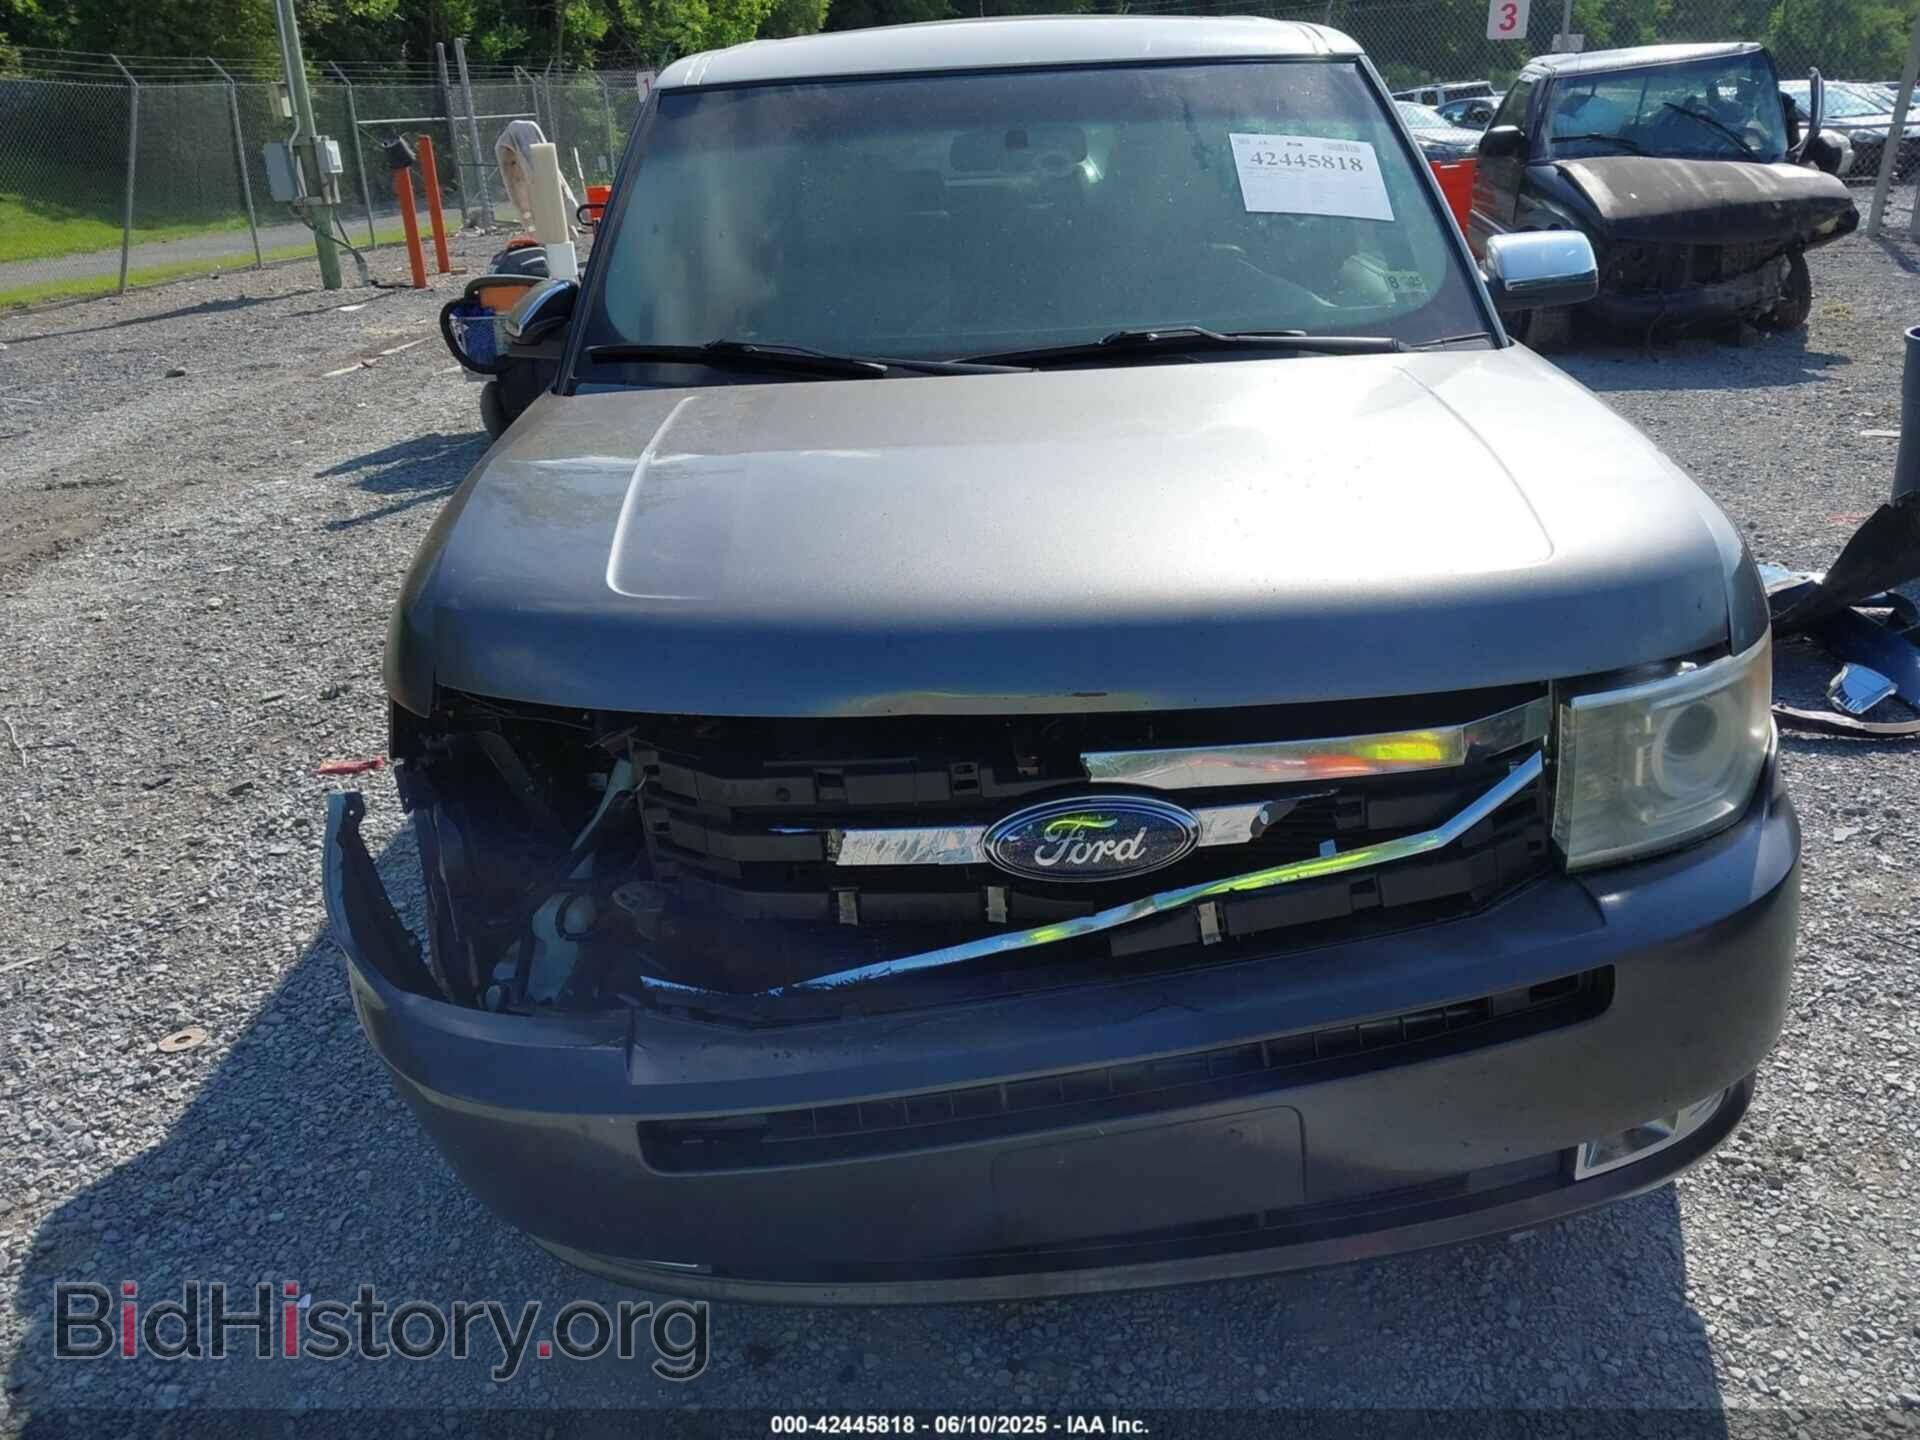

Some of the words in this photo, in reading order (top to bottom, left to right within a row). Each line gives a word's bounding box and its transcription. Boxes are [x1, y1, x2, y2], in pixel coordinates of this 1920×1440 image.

[1499, 3, 1517, 31] 3
[1250, 151, 1365, 172] 42445818
[1034, 818, 1148, 866] Ford
